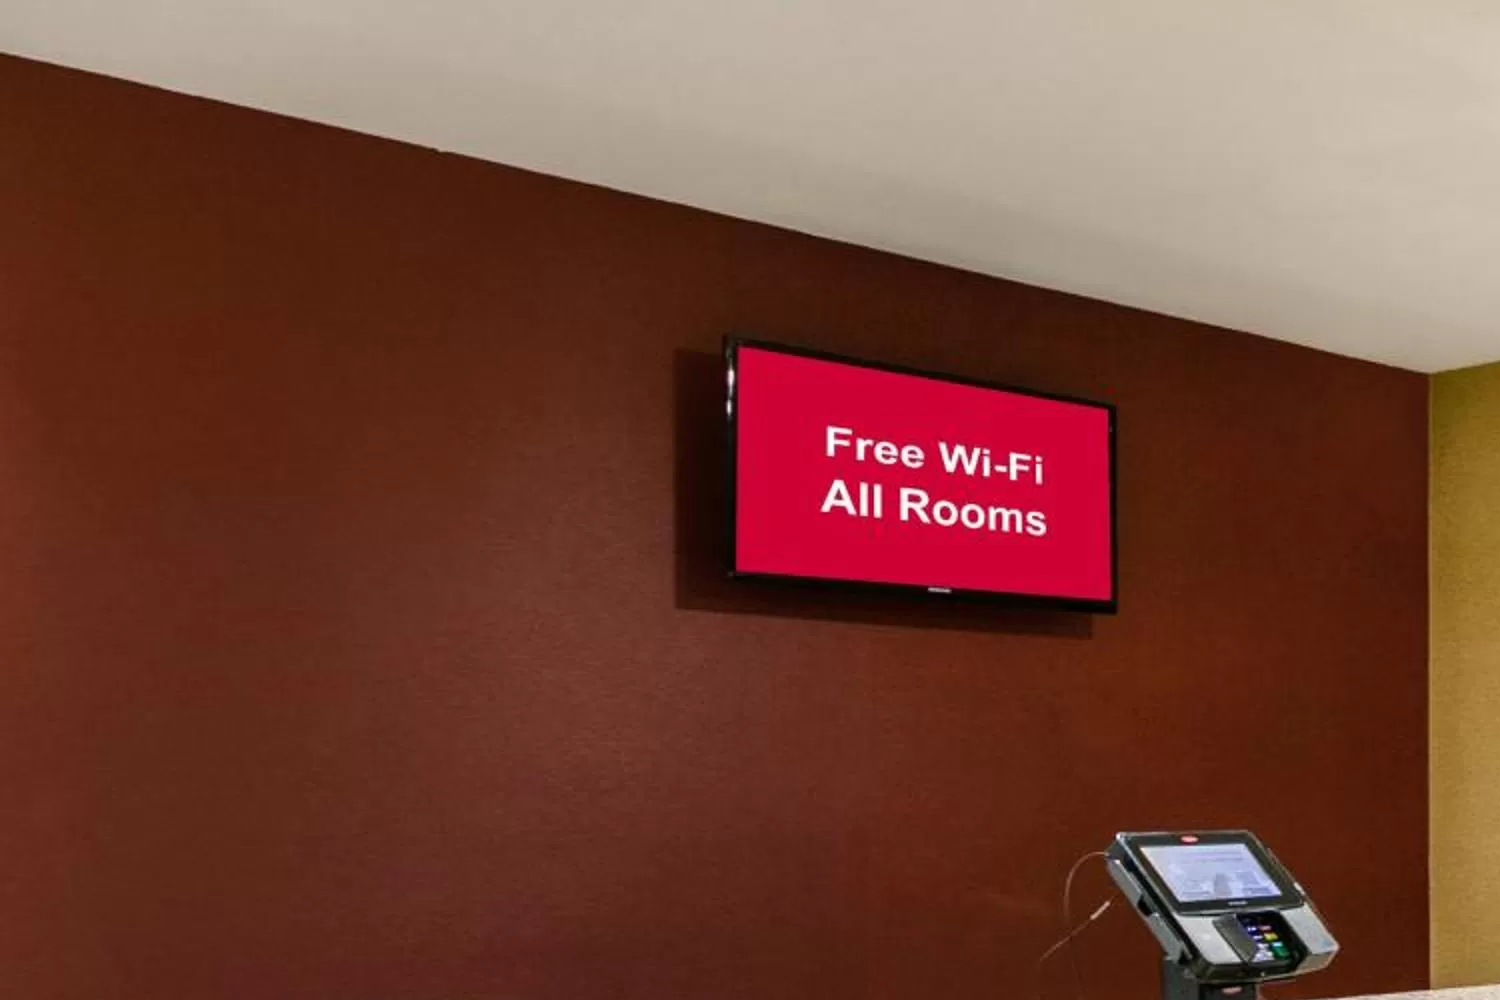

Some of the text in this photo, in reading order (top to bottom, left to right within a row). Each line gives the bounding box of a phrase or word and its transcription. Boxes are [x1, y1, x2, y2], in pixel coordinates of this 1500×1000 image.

[825, 425, 1043, 484] Free Wi-Fi
[821, 479, 1047, 537] All Rooms
